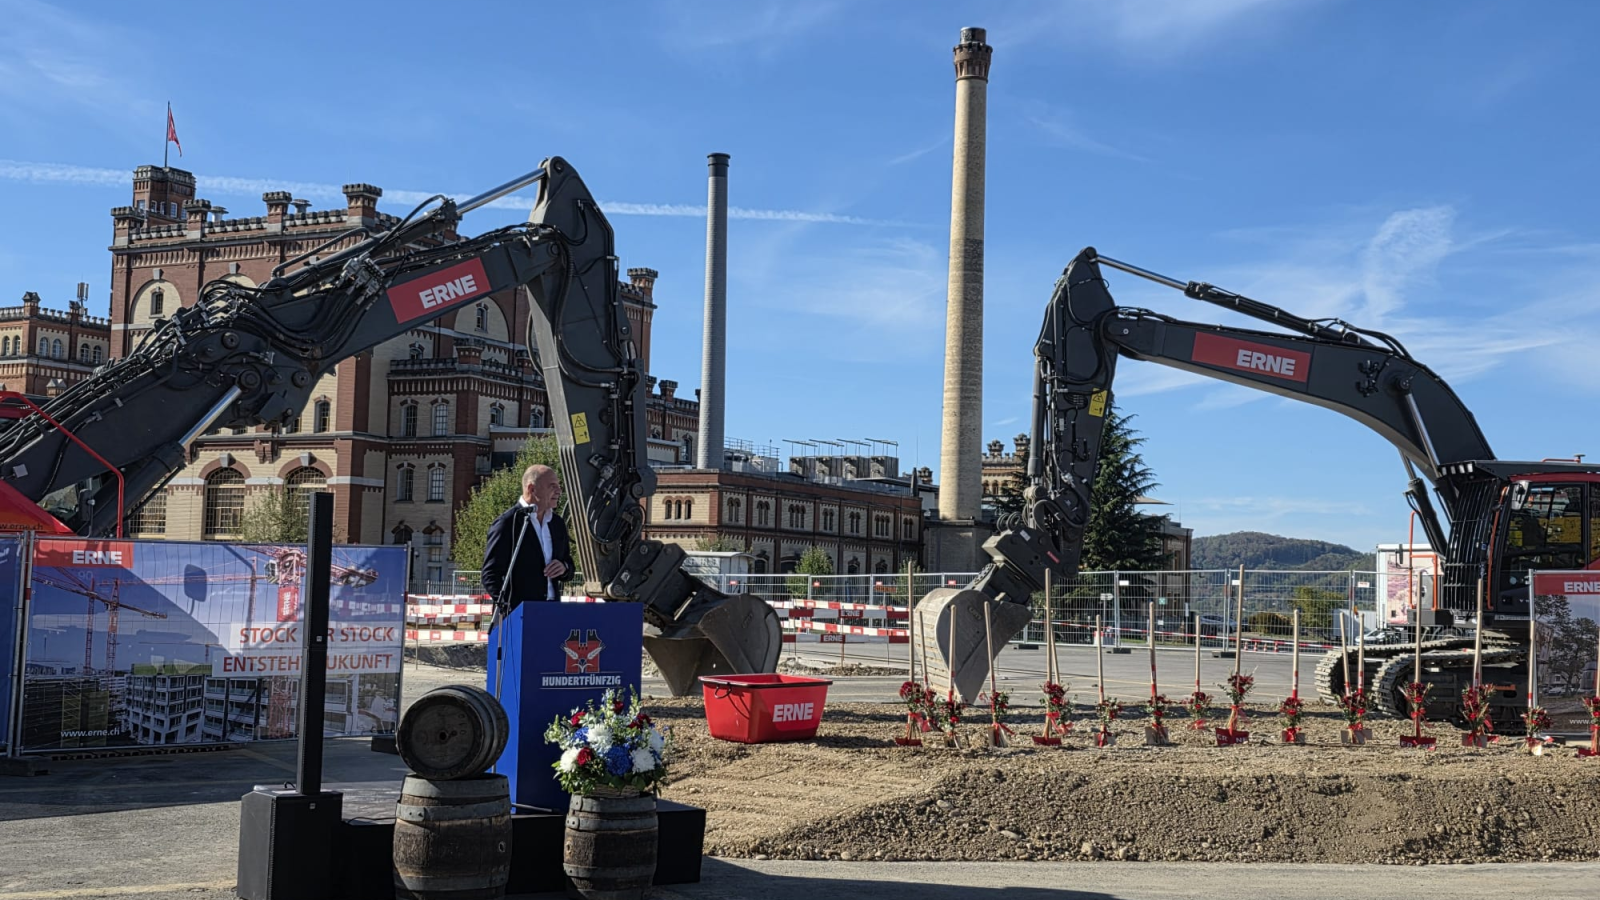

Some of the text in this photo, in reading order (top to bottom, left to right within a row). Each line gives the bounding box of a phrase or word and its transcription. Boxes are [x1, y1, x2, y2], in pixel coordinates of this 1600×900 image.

[419, 274, 477, 309] ERNE
[1237, 349, 1295, 376] ERNE
[72, 550, 122, 565] ERNE
[239, 627, 297, 644] STOCK
[340, 626, 394, 642] STOCK
[223, 654, 393, 672] ENTSTEH UKUNFT
[542, 674, 621, 686] HUNDERTFÜNFZIG
[772, 702, 814, 723] ERNE
[61, 727, 120, 738] www.erne.ch
